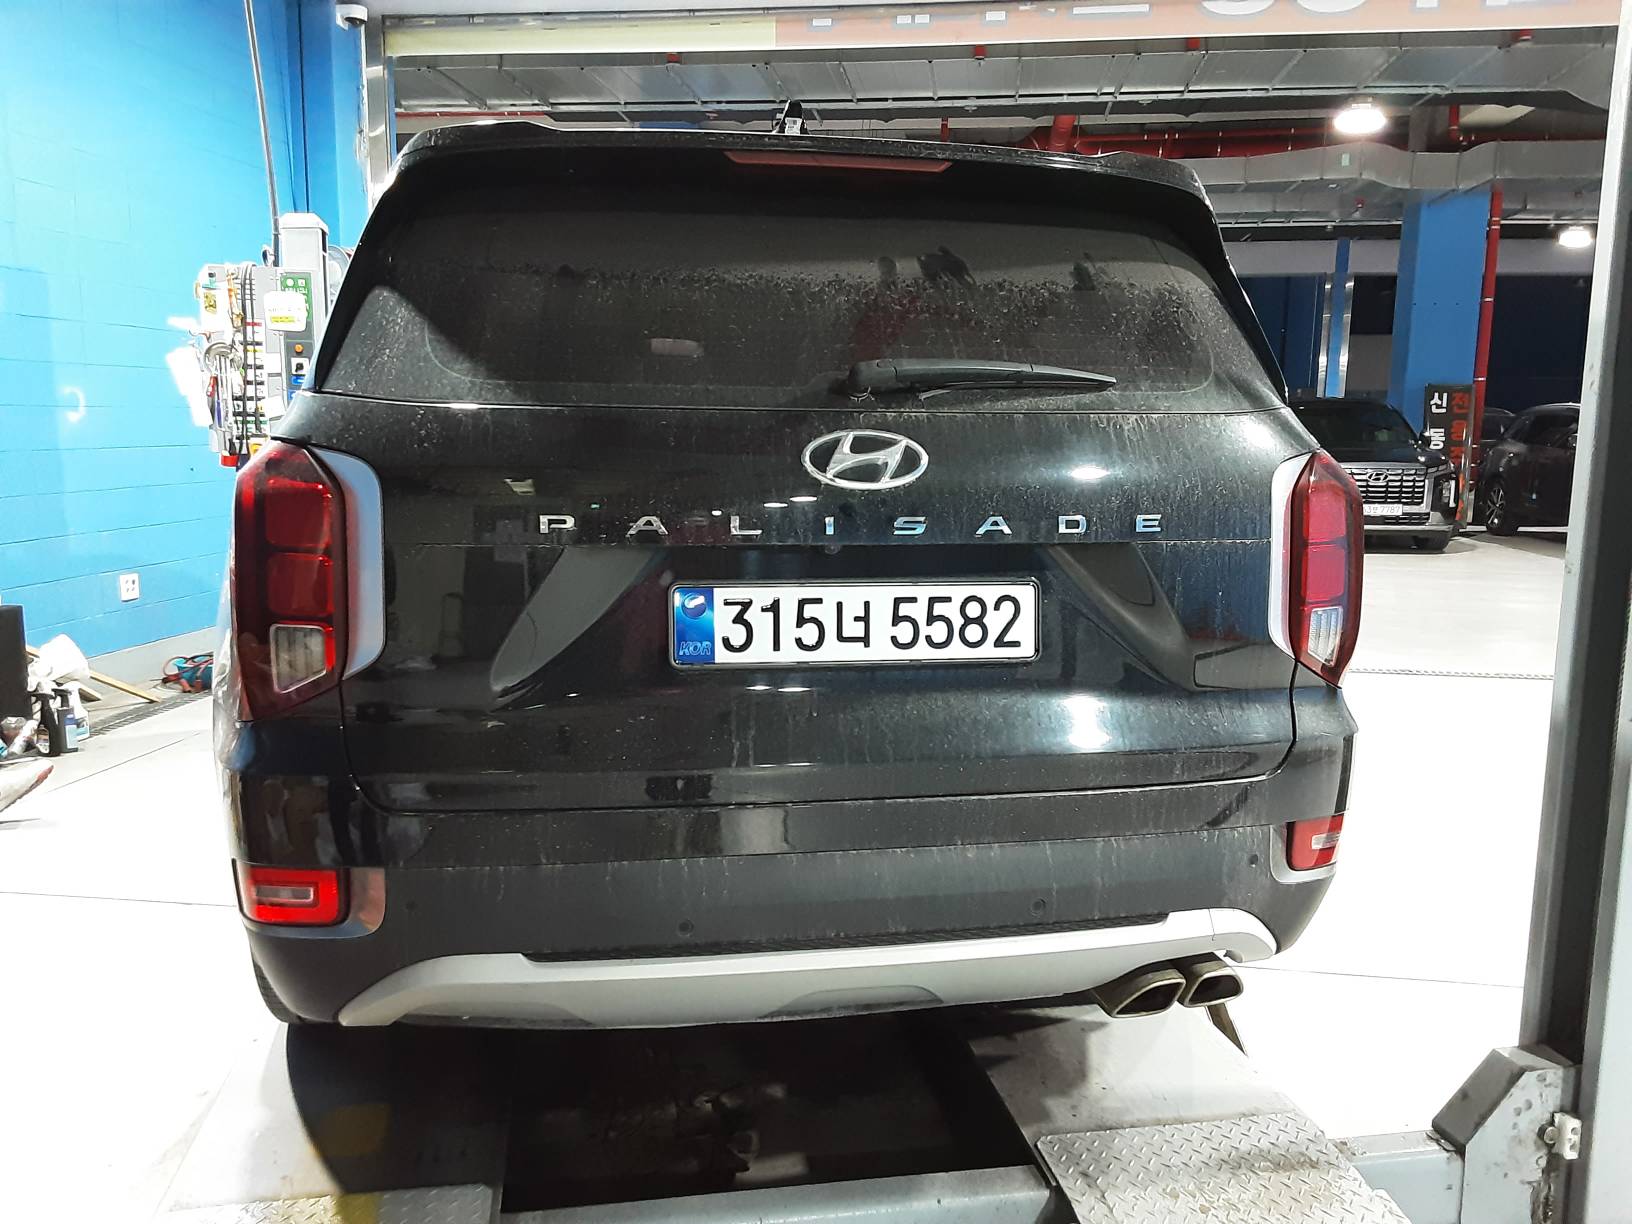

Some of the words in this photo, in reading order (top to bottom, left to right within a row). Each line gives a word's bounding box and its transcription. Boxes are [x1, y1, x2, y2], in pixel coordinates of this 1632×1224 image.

[539, 514, 1162, 536] PALISADE
[721, 597, 870, 653] 315너
[890, 594, 1022, 651] 5582
[678, 640, 712, 657] KOR
